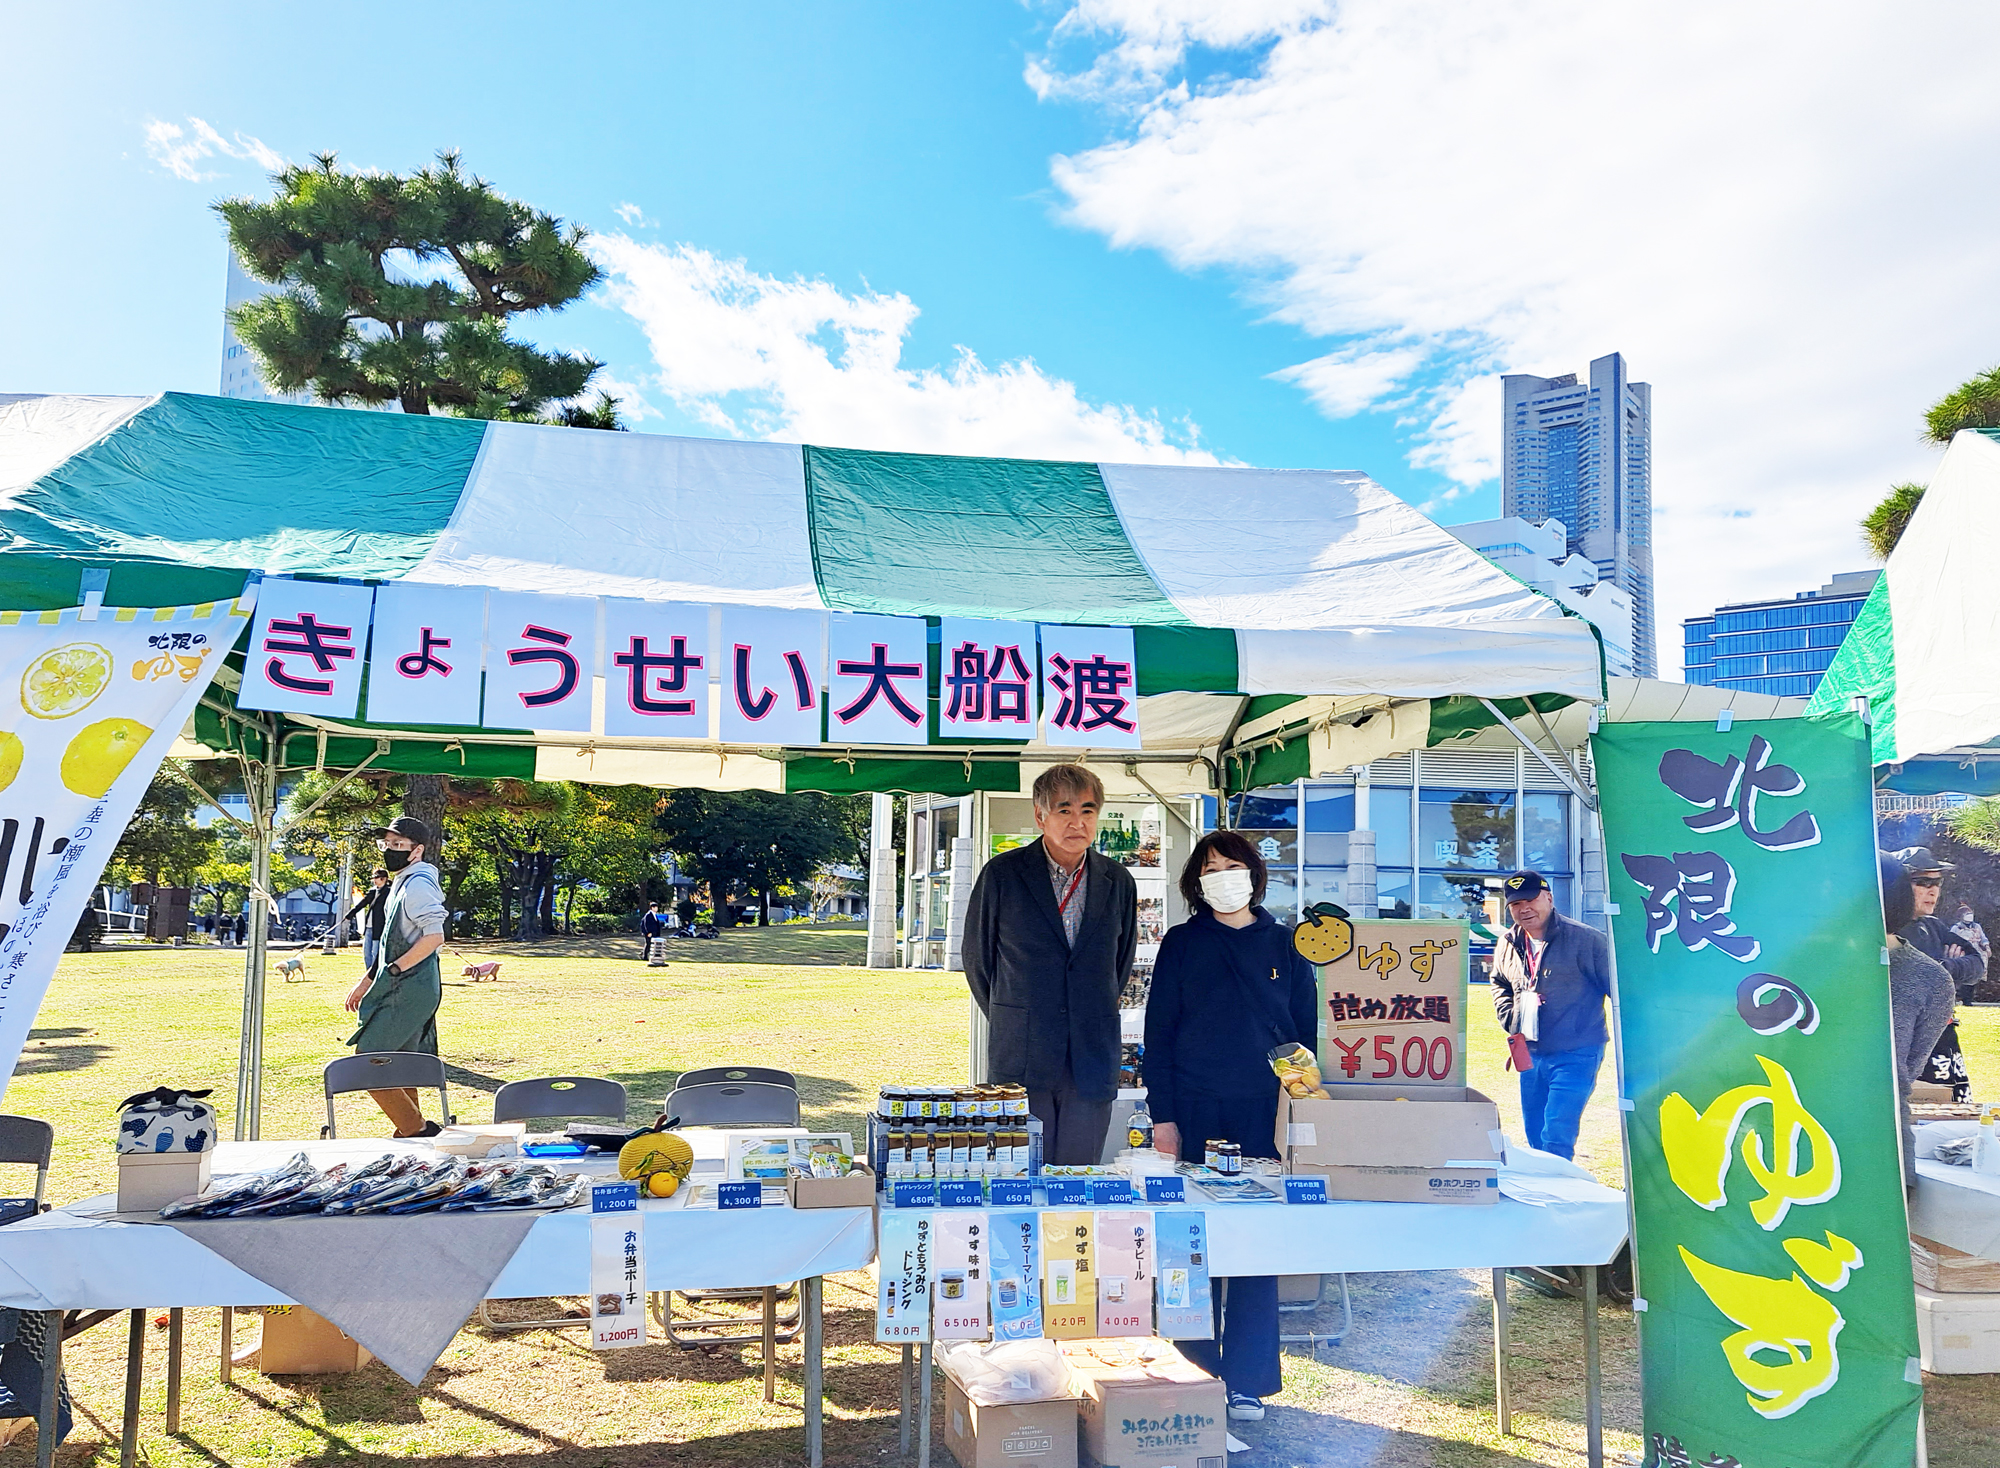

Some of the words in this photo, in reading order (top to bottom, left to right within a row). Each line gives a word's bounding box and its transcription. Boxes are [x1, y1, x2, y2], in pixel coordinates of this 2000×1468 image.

[148, 632, 207, 650] 北限の
[131, 647, 212, 683] ゆず
[263, 612, 1137, 734] きょうせい大船渡
[1434, 840, 1500, 866] 喫茶
[1358, 939, 1458, 982] ゆず
[1328, 991, 1451, 1024] 詰め放題
[1621, 734, 1864, 1420] 北限のゆず
[594, 1187, 629, 1196] お弁当ポーチ
[911, 1195, 934, 1204] 680円
[1063, 1194, 1086, 1203] 420円
[1109, 1194, 1132, 1202] 400円
[914, 1219, 929, 1295] ゆずともろみの
[968, 1224, 980, 1280] ゆず味噌
[1075, 1225, 1089, 1272] ゆず塩
[624, 1230, 637, 1305] お弁当ポーチ
[1021, 1222, 1034, 1307] ゆずマーマレード
[901, 1250, 913, 1310] ドレッシング
[944, 1318, 980, 1328] 650円
[1003, 1320, 1036, 1331] 650円
[1051, 1316, 1086, 1327] 420円
[1104, 1317, 1139, 1327] 400円
[1167, 1315, 1203, 1324] 400円
[599, 1328, 638, 1342] 1,200円
[885, 1327, 920, 1336] 680円
[1121, 1413, 1215, 1434] みちのく産まれの
[1136, 1432, 1200, 1448] こだわりたまご
